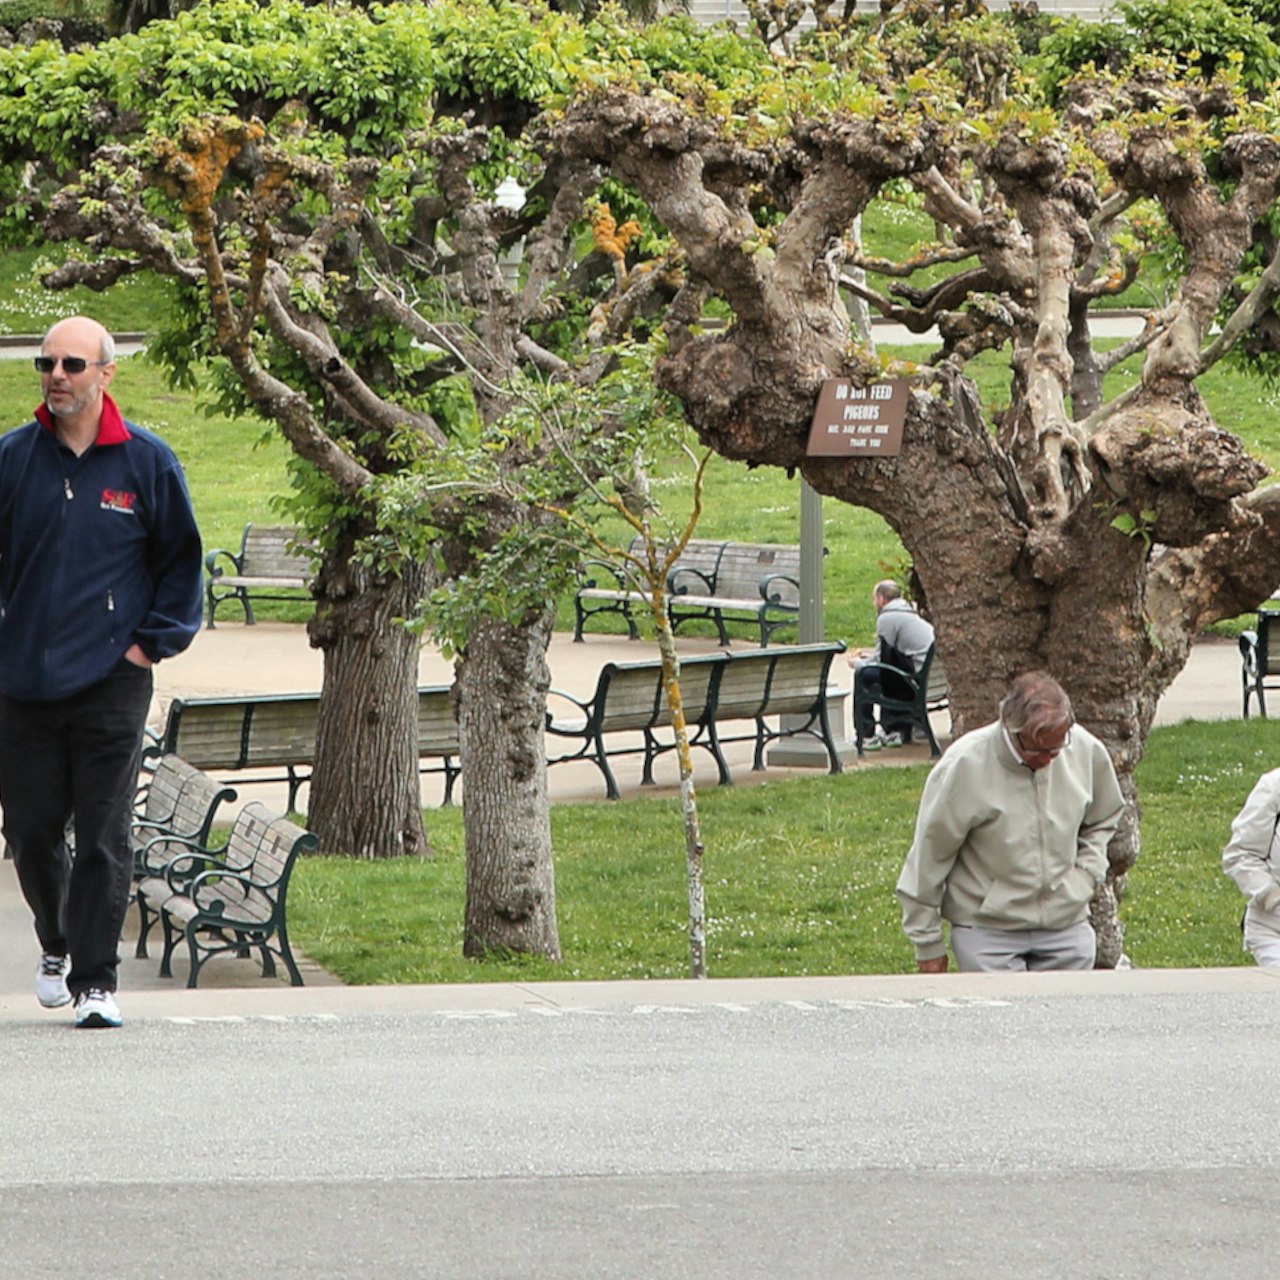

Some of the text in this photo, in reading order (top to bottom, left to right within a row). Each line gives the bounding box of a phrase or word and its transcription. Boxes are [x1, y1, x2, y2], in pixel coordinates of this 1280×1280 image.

[835, 385, 848, 400] DO
[870, 385, 893, 400] FEED
[843, 404, 880, 420] PIGEONS
[869, 438, 881, 448] YOU
